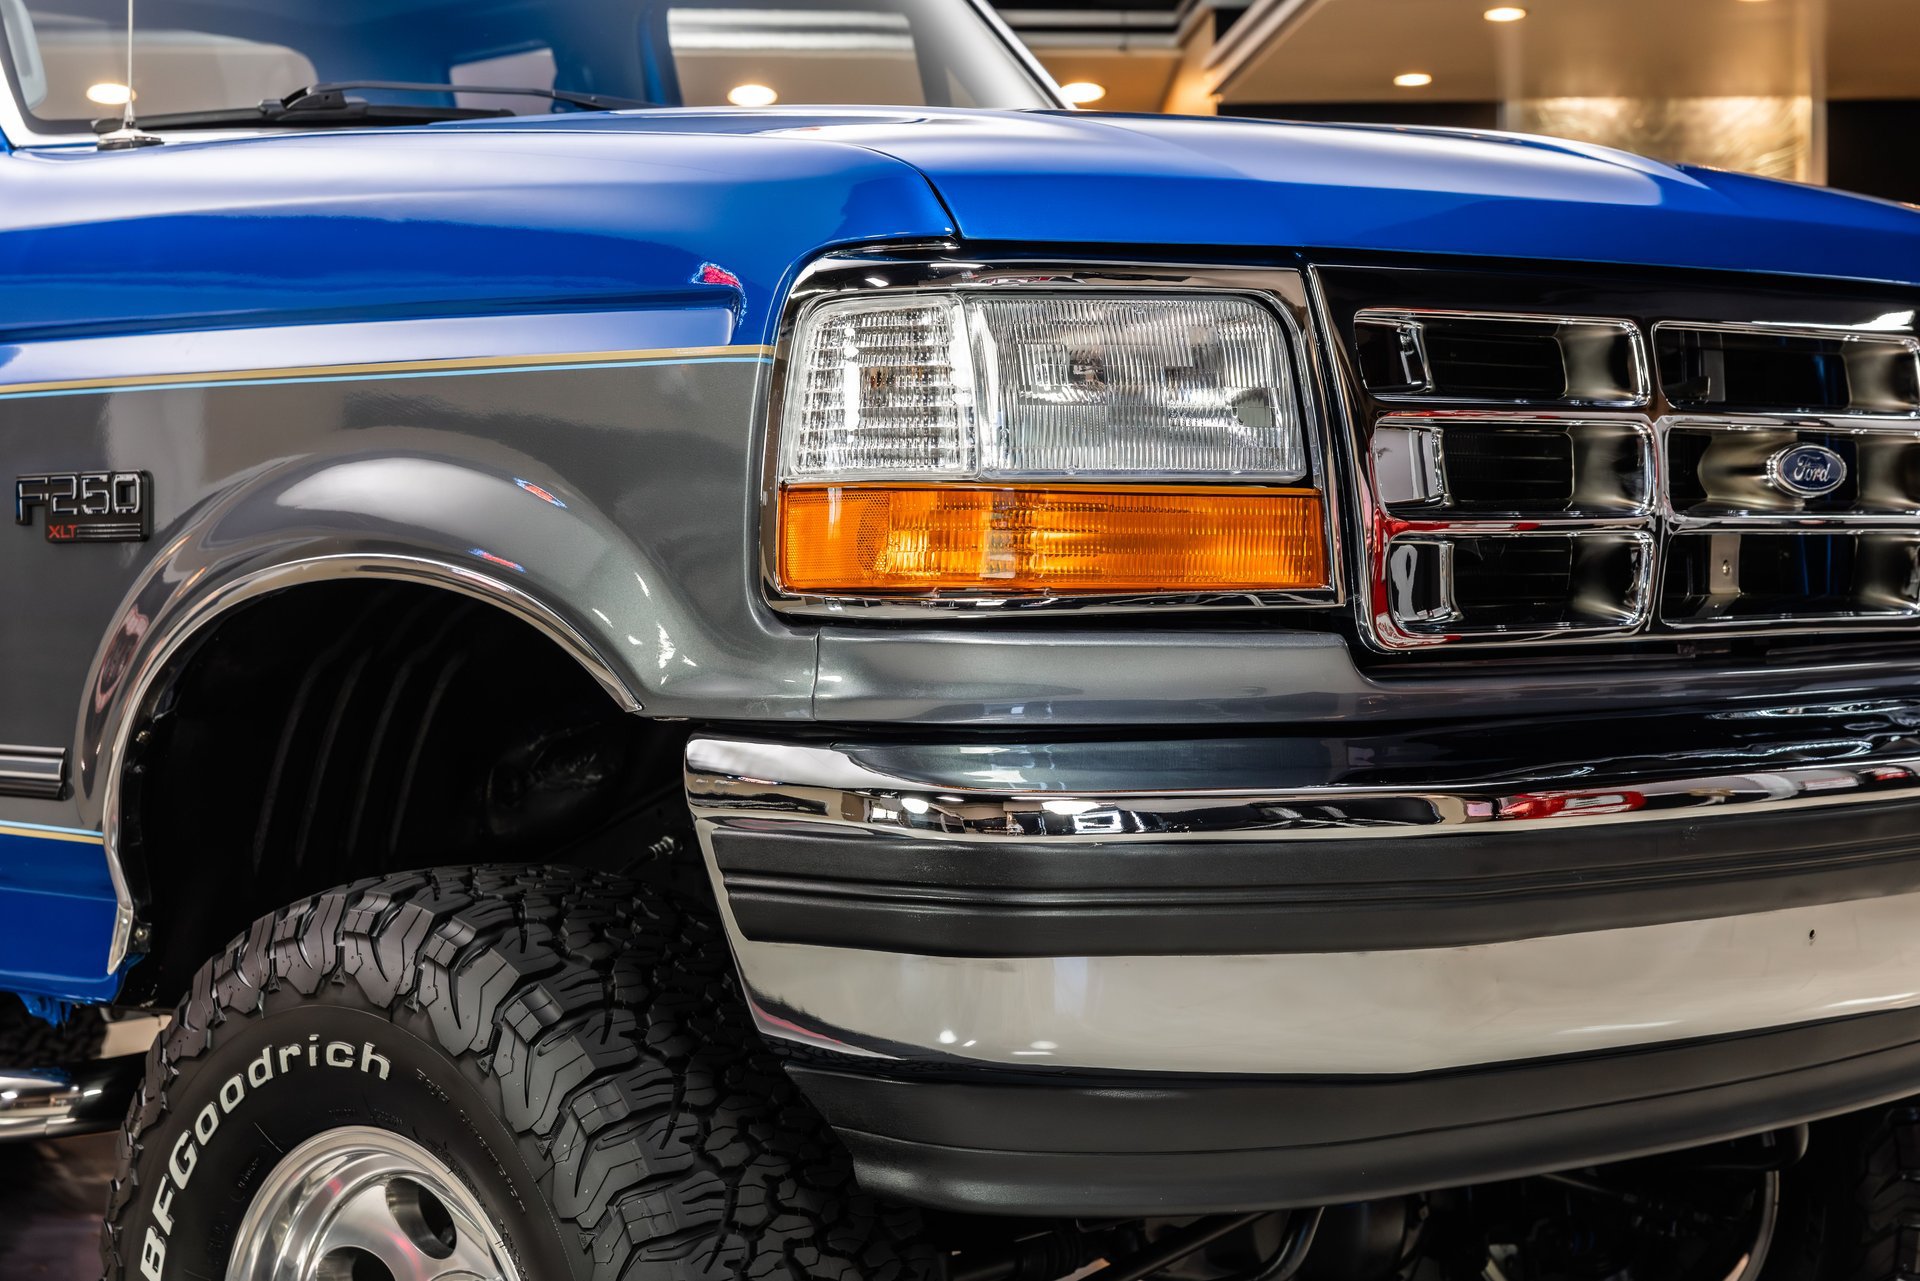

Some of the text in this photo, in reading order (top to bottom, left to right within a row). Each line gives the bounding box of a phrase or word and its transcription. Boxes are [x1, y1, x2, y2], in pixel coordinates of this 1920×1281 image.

[1793, 454, 1832, 482] Ford
[16, 472, 142, 525] F250
[48, 525, 78, 539] XLT
[140, 1034, 392, 1281] BFGoodrich
